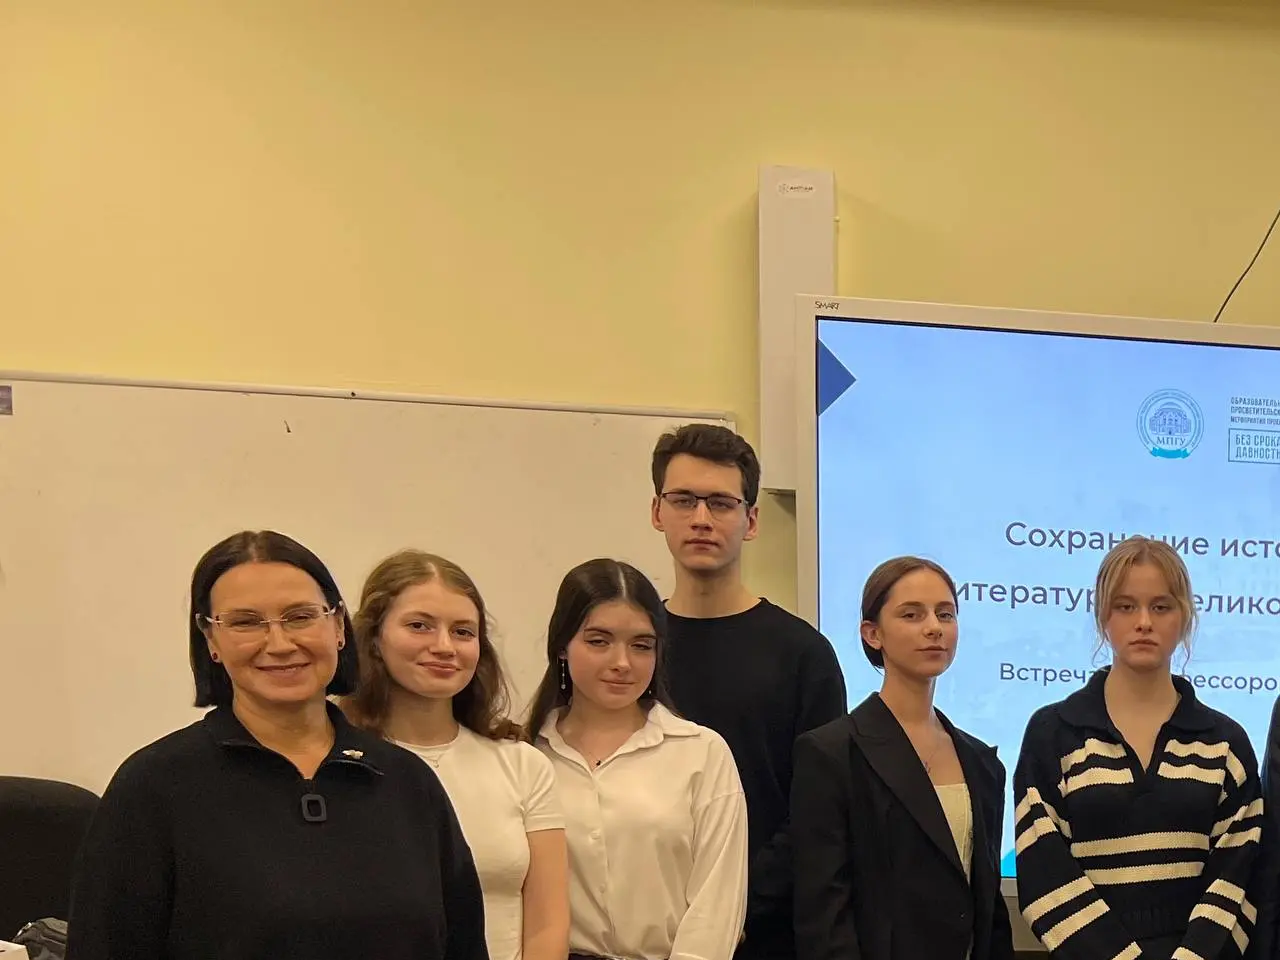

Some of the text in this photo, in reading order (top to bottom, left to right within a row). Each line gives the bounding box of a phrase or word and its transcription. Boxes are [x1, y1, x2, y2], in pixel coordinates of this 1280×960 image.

[815, 301, 840, 310] SMART
[1157, 436, 1186, 446] МПГУ
[1235, 434, 1251, 446] БЕЗ
